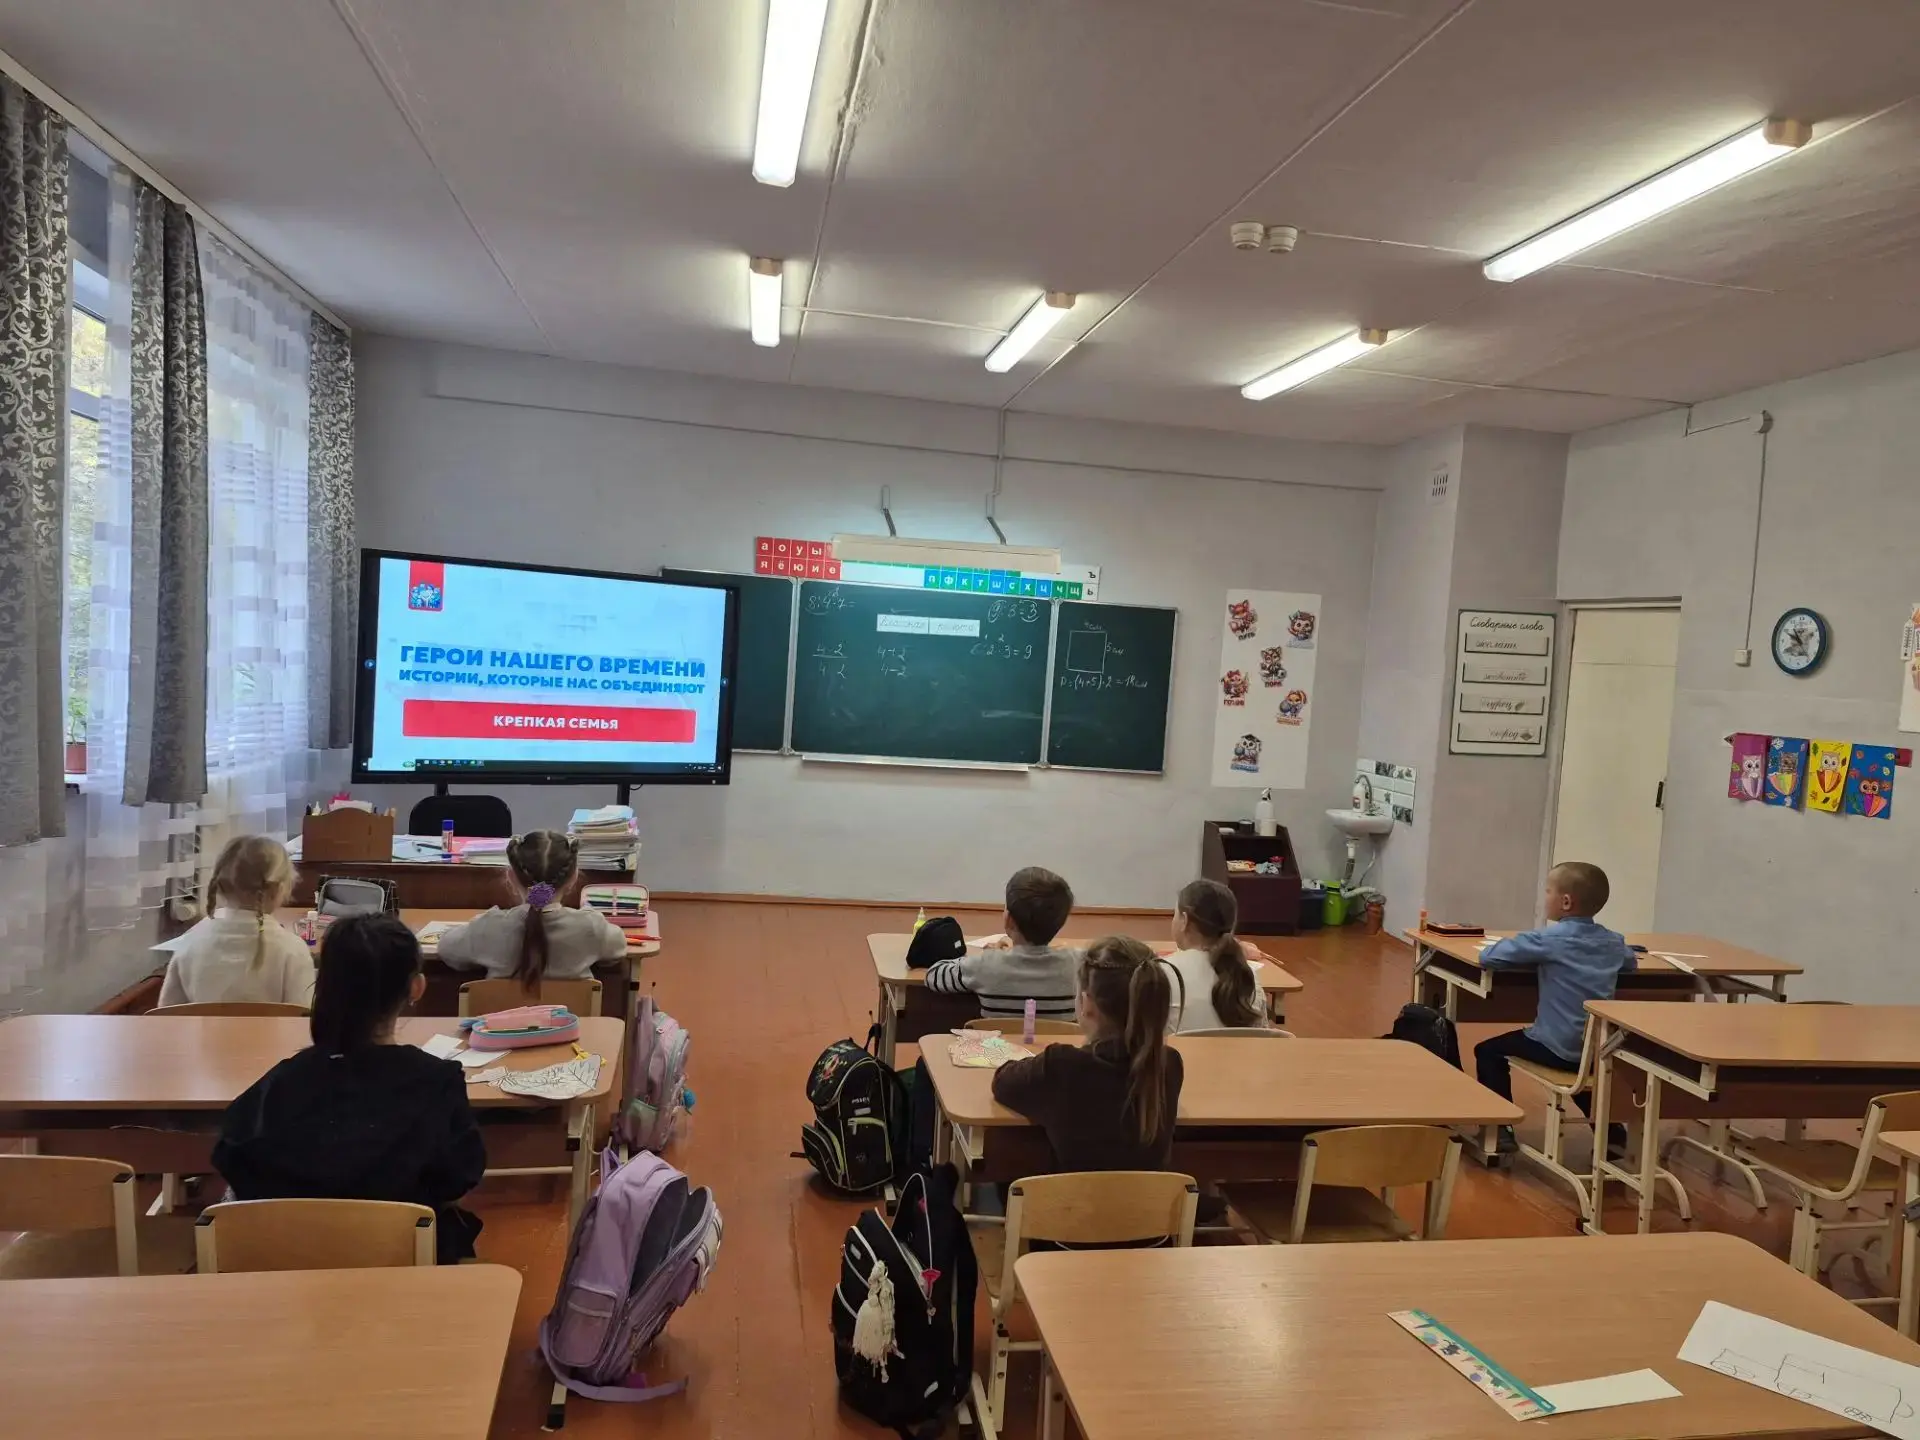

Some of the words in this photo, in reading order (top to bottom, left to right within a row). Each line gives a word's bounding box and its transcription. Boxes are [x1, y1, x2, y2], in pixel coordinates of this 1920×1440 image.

[400, 645, 483, 666] ГЕРОИ
[490, 650, 594, 672] НАШЕГО
[600, 657, 705, 678] ВРЕМЕНИ
[399, 669, 485, 686] ИСТОРИИ,
[487, 673, 563, 688] КОТОРЫЕ
[567, 677, 597, 689] НАС
[601, 679, 706, 694] ОБЪЕДИНЯЮТ
[493, 715, 565, 729] КРЕПКАЯ
[569, 718, 619, 730] СЕМЬЯ
